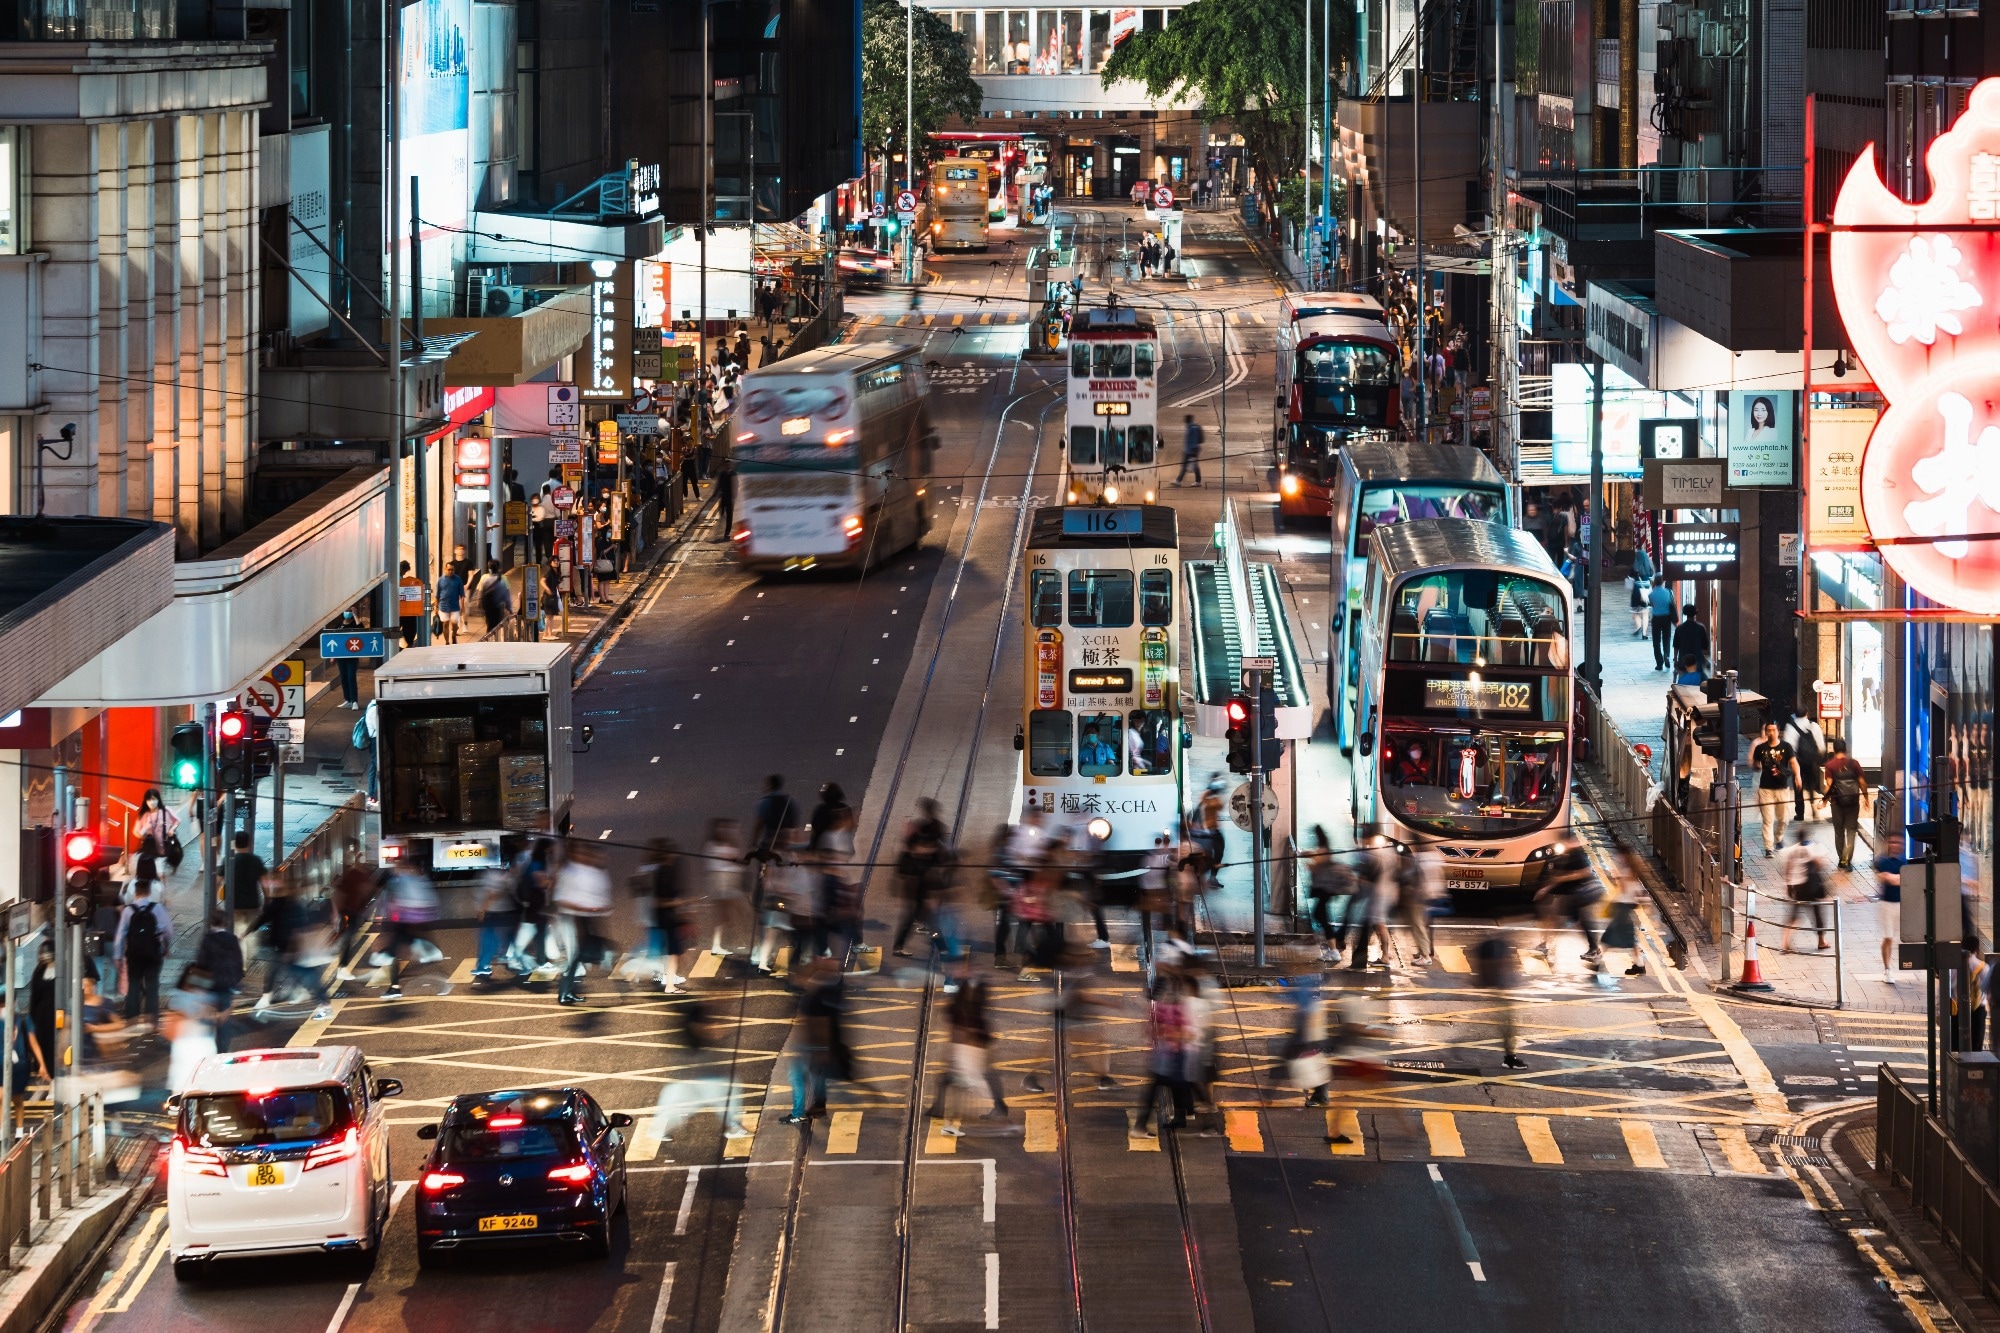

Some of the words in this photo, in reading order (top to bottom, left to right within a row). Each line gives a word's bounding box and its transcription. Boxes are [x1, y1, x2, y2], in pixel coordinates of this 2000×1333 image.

[1106, 311, 1119, 322] 21
[568, 404, 574, 413] 7
[568, 415, 574, 423] 7
[630, 426, 638, 434] 12
[650, 426, 658, 434] 12
[1671, 477, 1714, 489] TIMELY
[1087, 512, 1118, 532] 116
[1033, 553, 1046, 565] 116
[1154, 553, 1168, 565] 116
[1081, 635, 1120, 645] X-CHA
[1081, 647, 1121, 667] 極茶
[1075, 677, 1105, 686] Kennedy
[1107, 677, 1124, 685] Town
[287, 689, 295, 699] 7
[1498, 684, 1529, 708] 182
[287, 705, 295, 716] 7
[1060, 793, 1101, 813] 極茶
[1105, 800, 1157, 814] X-CHA
[257, 1165, 273, 1175] BD
[256, 1175, 276, 1185] 150
[482, 1221, 497, 1229] XF
[503, 1217, 535, 1227] 9246
